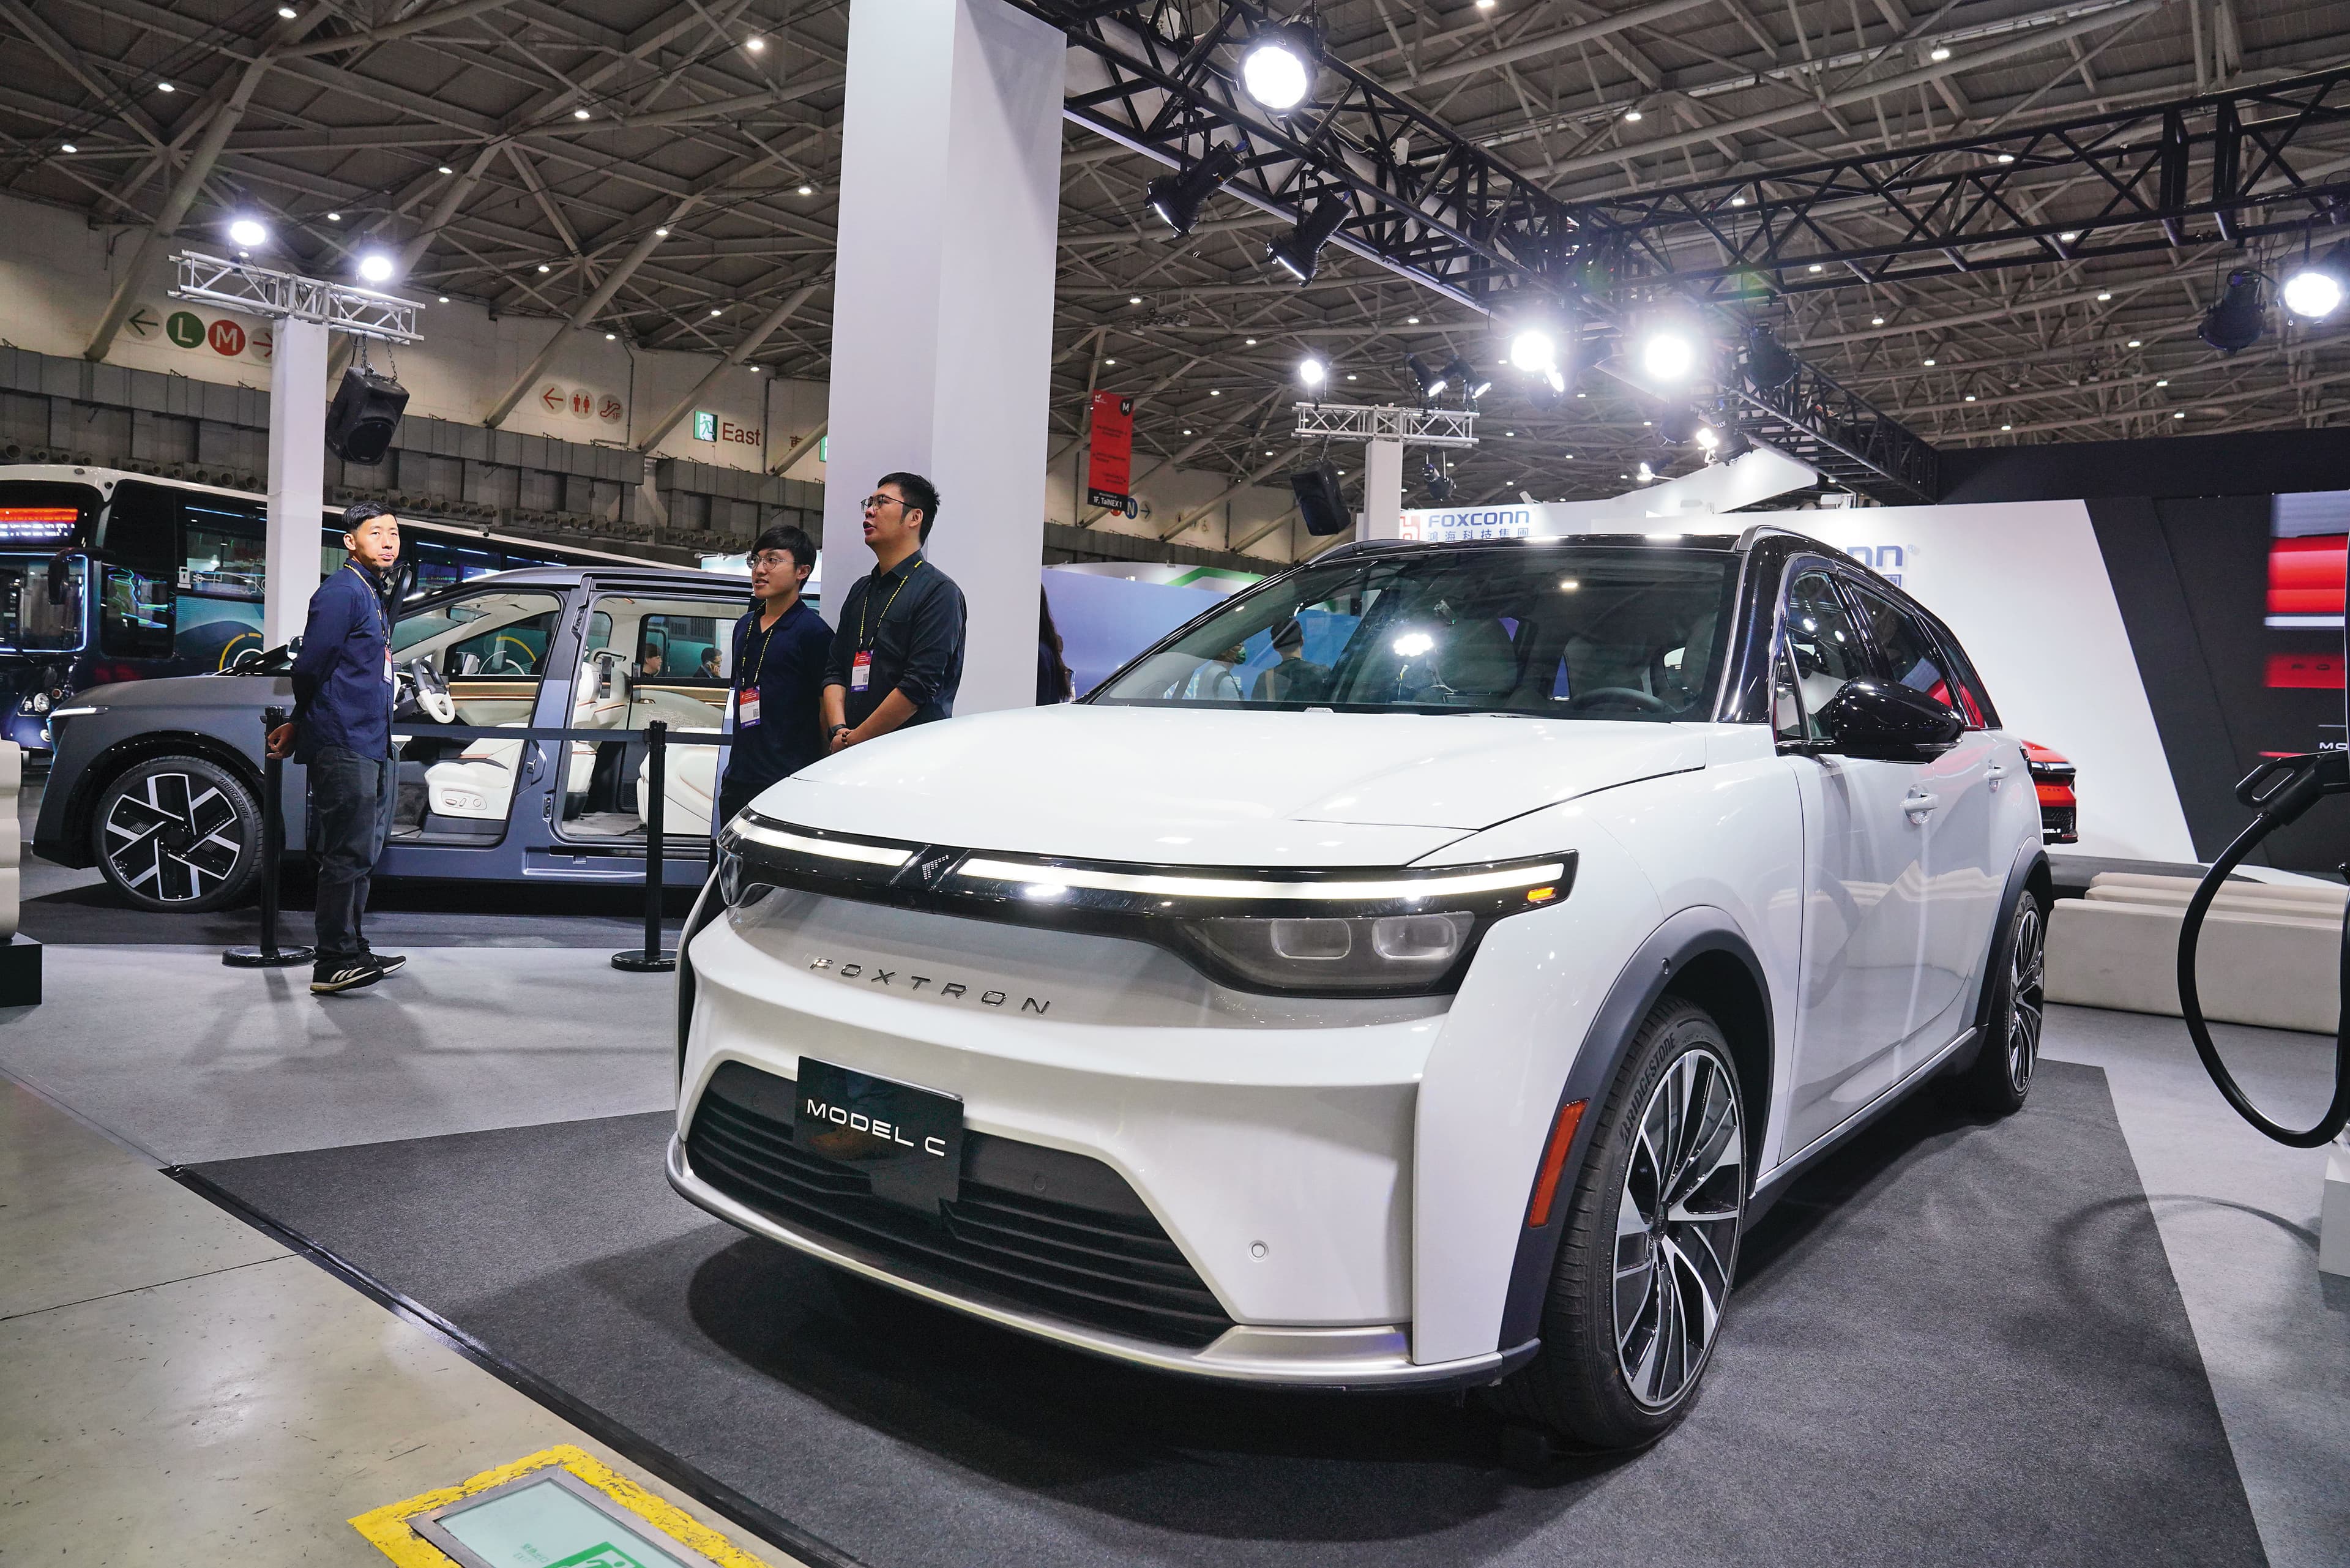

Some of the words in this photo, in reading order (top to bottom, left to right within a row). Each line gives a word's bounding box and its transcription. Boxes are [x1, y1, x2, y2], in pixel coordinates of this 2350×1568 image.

[177, 317, 193, 343] L
[215, 324, 237, 352] M
[1122, 402, 1130, 412] M
[722, 422, 761, 446] East
[1127, 501, 1135, 517] N
[217, 778, 250, 821] BRIDGESTONE
[809, 957, 1051, 1017] FOXTRON
[1619, 1032, 1676, 1147] BRIDGESTONE
[807, 1099, 914, 1148] MODEL
[925, 1136, 946, 1157] C
